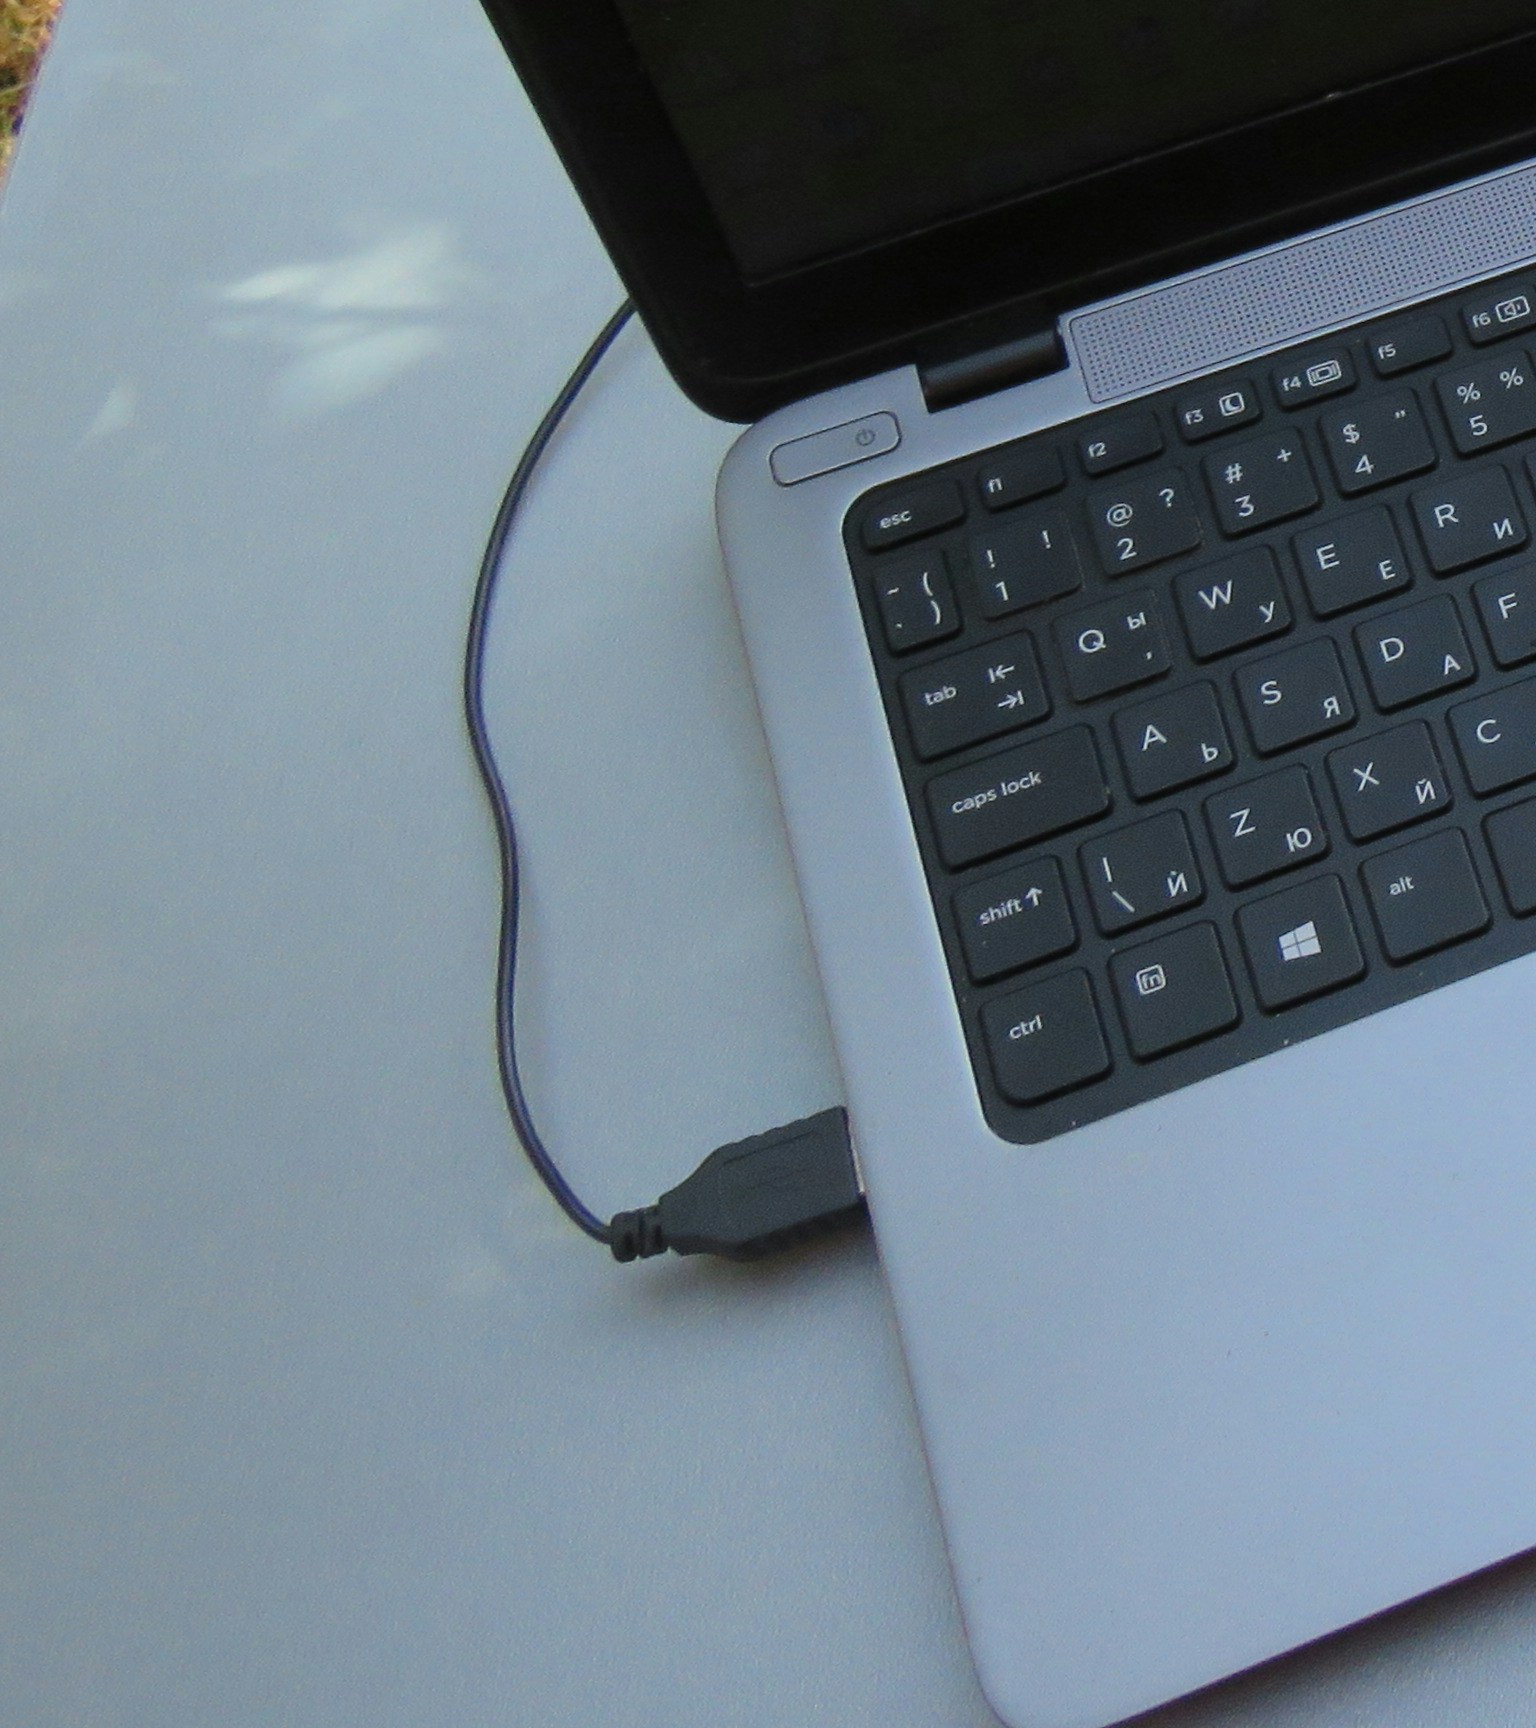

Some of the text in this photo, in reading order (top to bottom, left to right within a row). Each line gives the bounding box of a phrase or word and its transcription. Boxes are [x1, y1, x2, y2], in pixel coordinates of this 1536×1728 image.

[1472, 312, 1491, 328] f6
[1378, 344, 1396, 359] f5
[1282, 376, 1301, 391] f4
[1500, 367, 1524, 389] %
[1457, 382, 1481, 404] %
[1184, 409, 1204, 425] f3
[1469, 415, 1487, 435] 5
[1343, 424, 1360, 444] $
[1088, 442, 1106, 458] f2
[1225, 463, 1243, 484] #
[1355, 454, 1374, 474] 4
[987, 478, 1002, 493] f1
[1106, 503, 1133, 527] @
[1235, 495, 1254, 517] 3
[1434, 504, 1459, 528] R
[880, 511, 911, 528] esc
[1117, 538, 1137, 560] 2
[1316, 544, 1340, 570] E
[995, 581, 1009, 601] 1
[1198, 580, 1232, 609] W
[1498, 593, 1517, 619] F
[1079, 629, 1106, 653] Q
[1378, 637, 1404, 663] D
[925, 686, 956, 705] tab
[1261, 681, 1282, 705] S
[1142, 724, 1167, 751] A
[1476, 719, 1501, 743] C
[1353, 762, 1379, 791] X
[952, 771, 1041, 813] caps lock
[1229, 808, 1256, 837] Z
[1390, 876, 1414, 895] alt
[980, 898, 1023, 925] shift
[1009, 1015, 1042, 1039] ctrl
